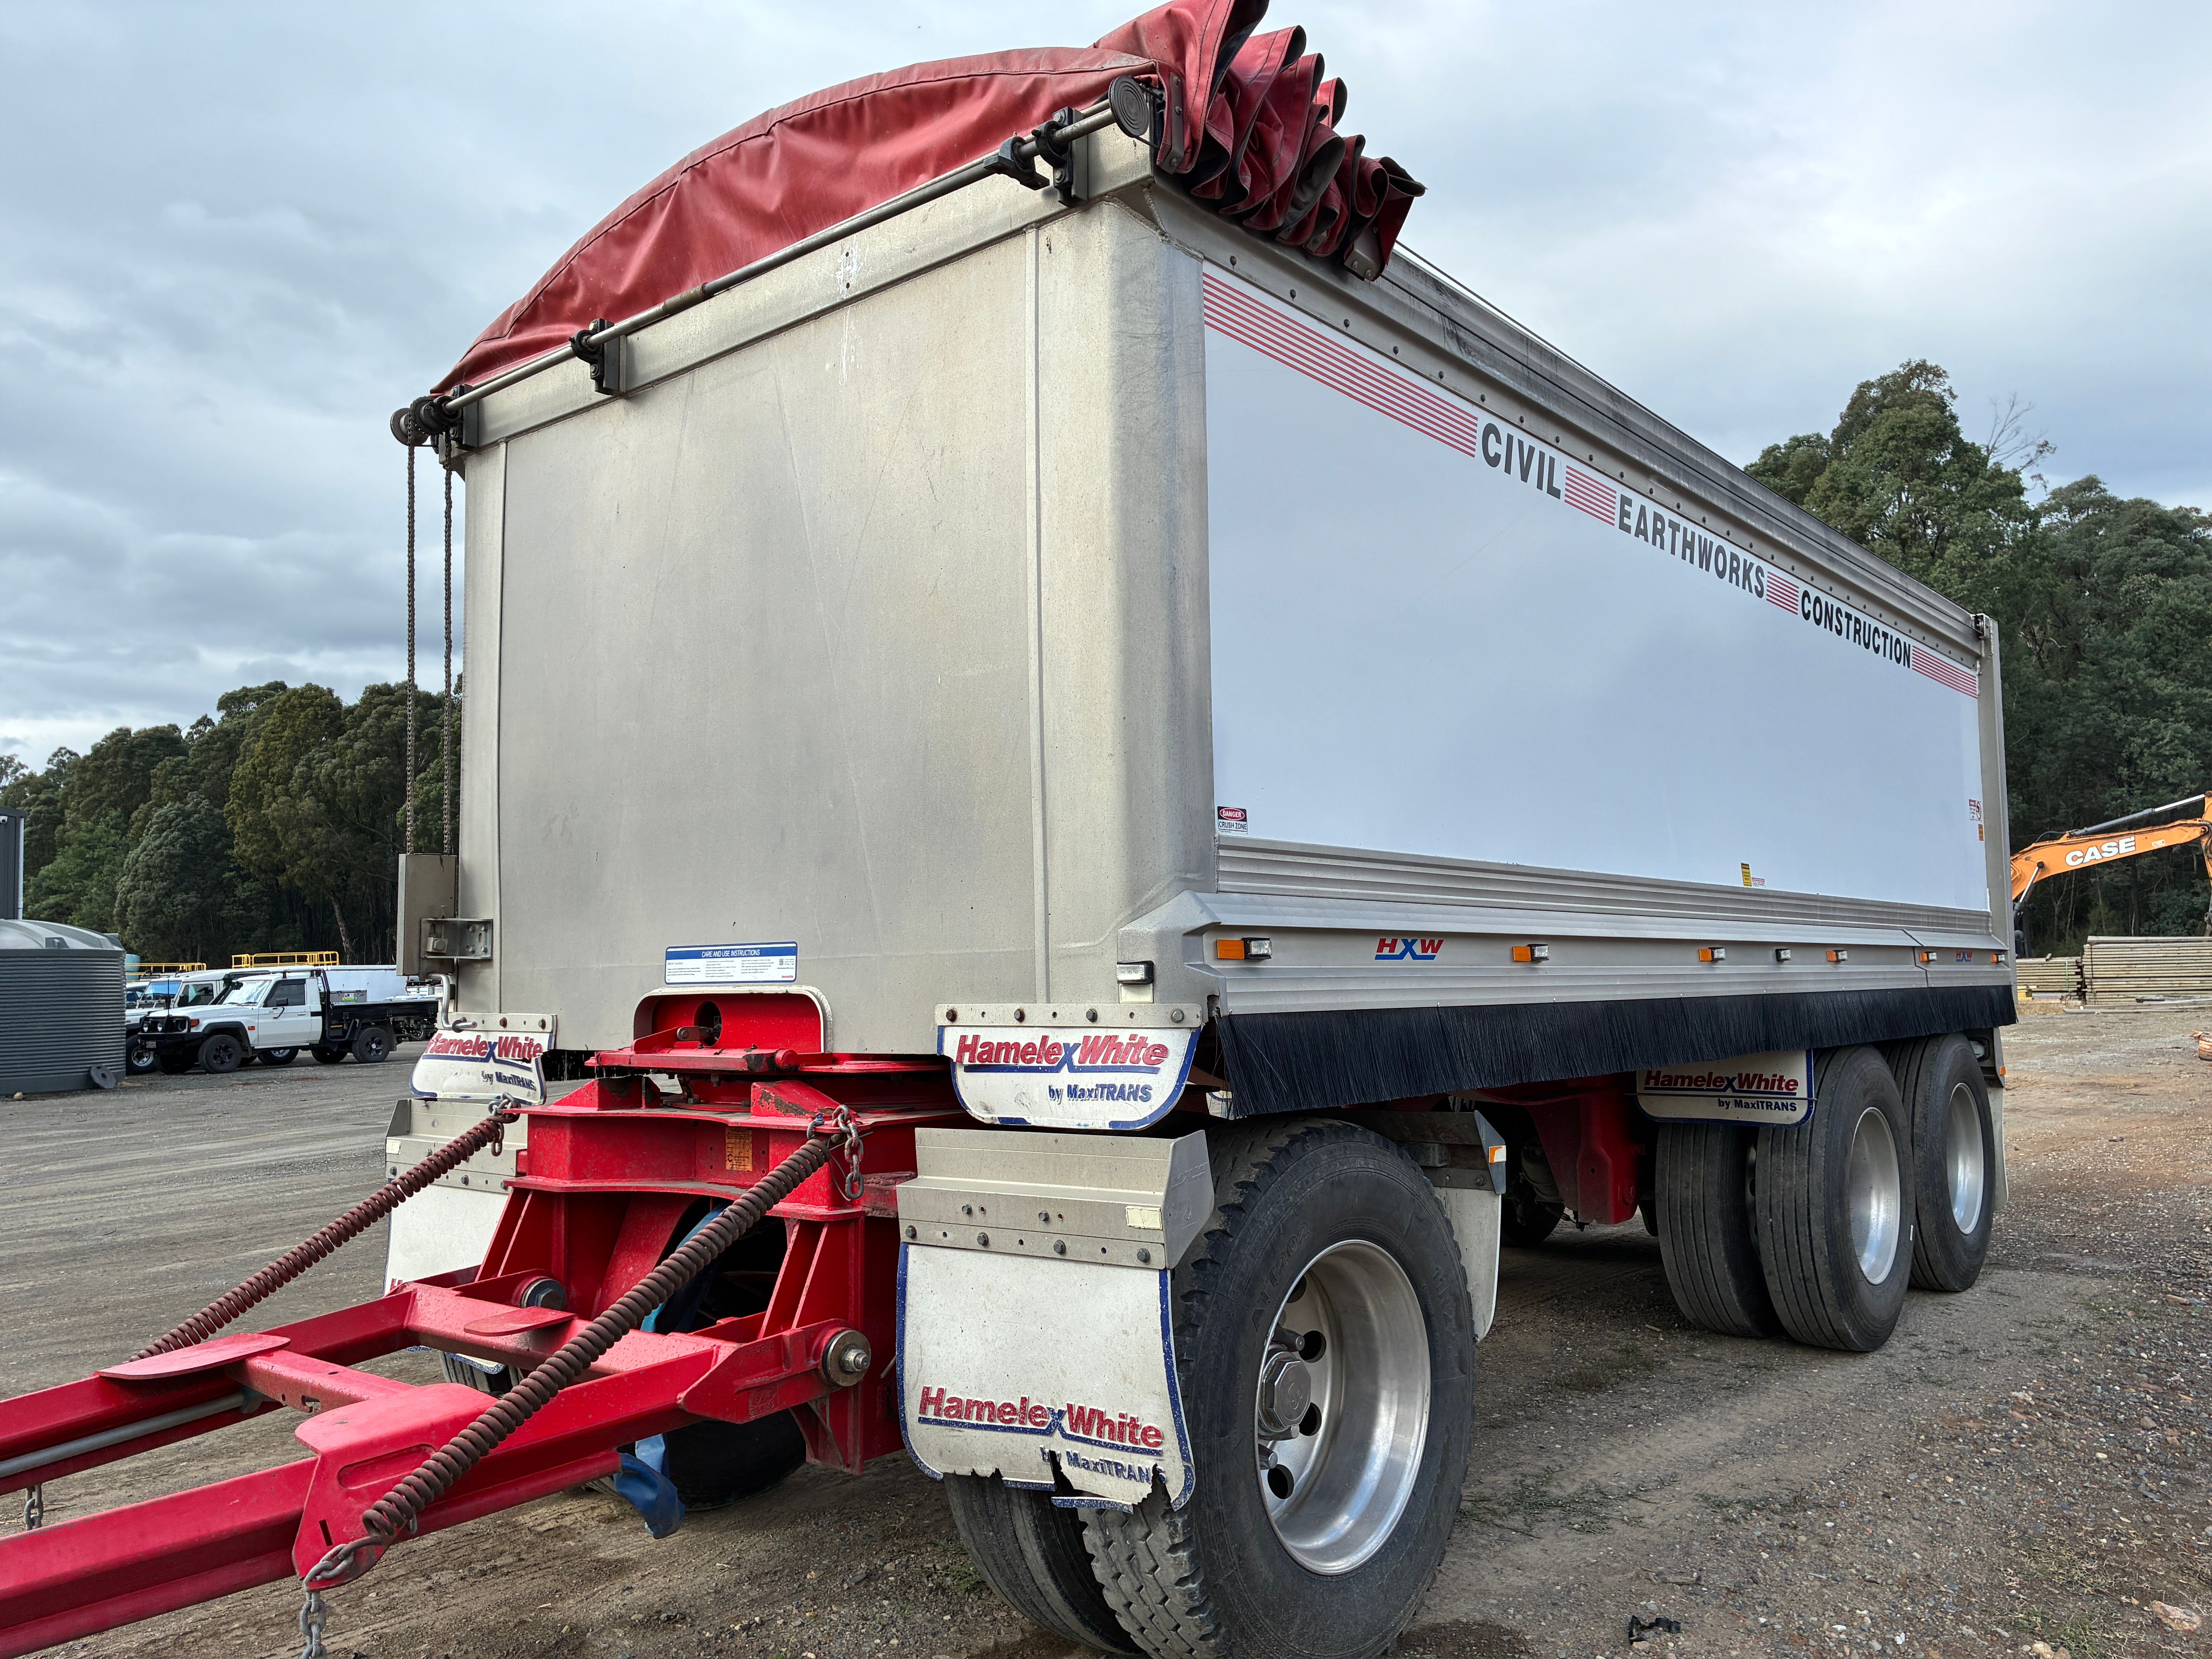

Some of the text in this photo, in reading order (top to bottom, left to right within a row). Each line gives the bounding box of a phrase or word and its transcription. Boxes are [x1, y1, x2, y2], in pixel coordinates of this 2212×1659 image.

[1482, 422, 1911, 669] CIVIL EARTHWORKS CONSTRUCTION
[2065, 836, 2136, 866] CASE
[1375, 938, 1444, 960] HXW
[1956, 951, 1973, 962] HXW
[956, 1034, 1168, 1069] HamelexWhite
[481, 1070, 493, 1085] by
[1645, 1070, 1799, 1092] HamelexWhite
[1048, 1084, 1153, 1104] by MaxiTRANS
[1718, 1098, 1797, 1112] by MaxiTRANS
[918, 1385, 1163, 1448] HamelexWhite
